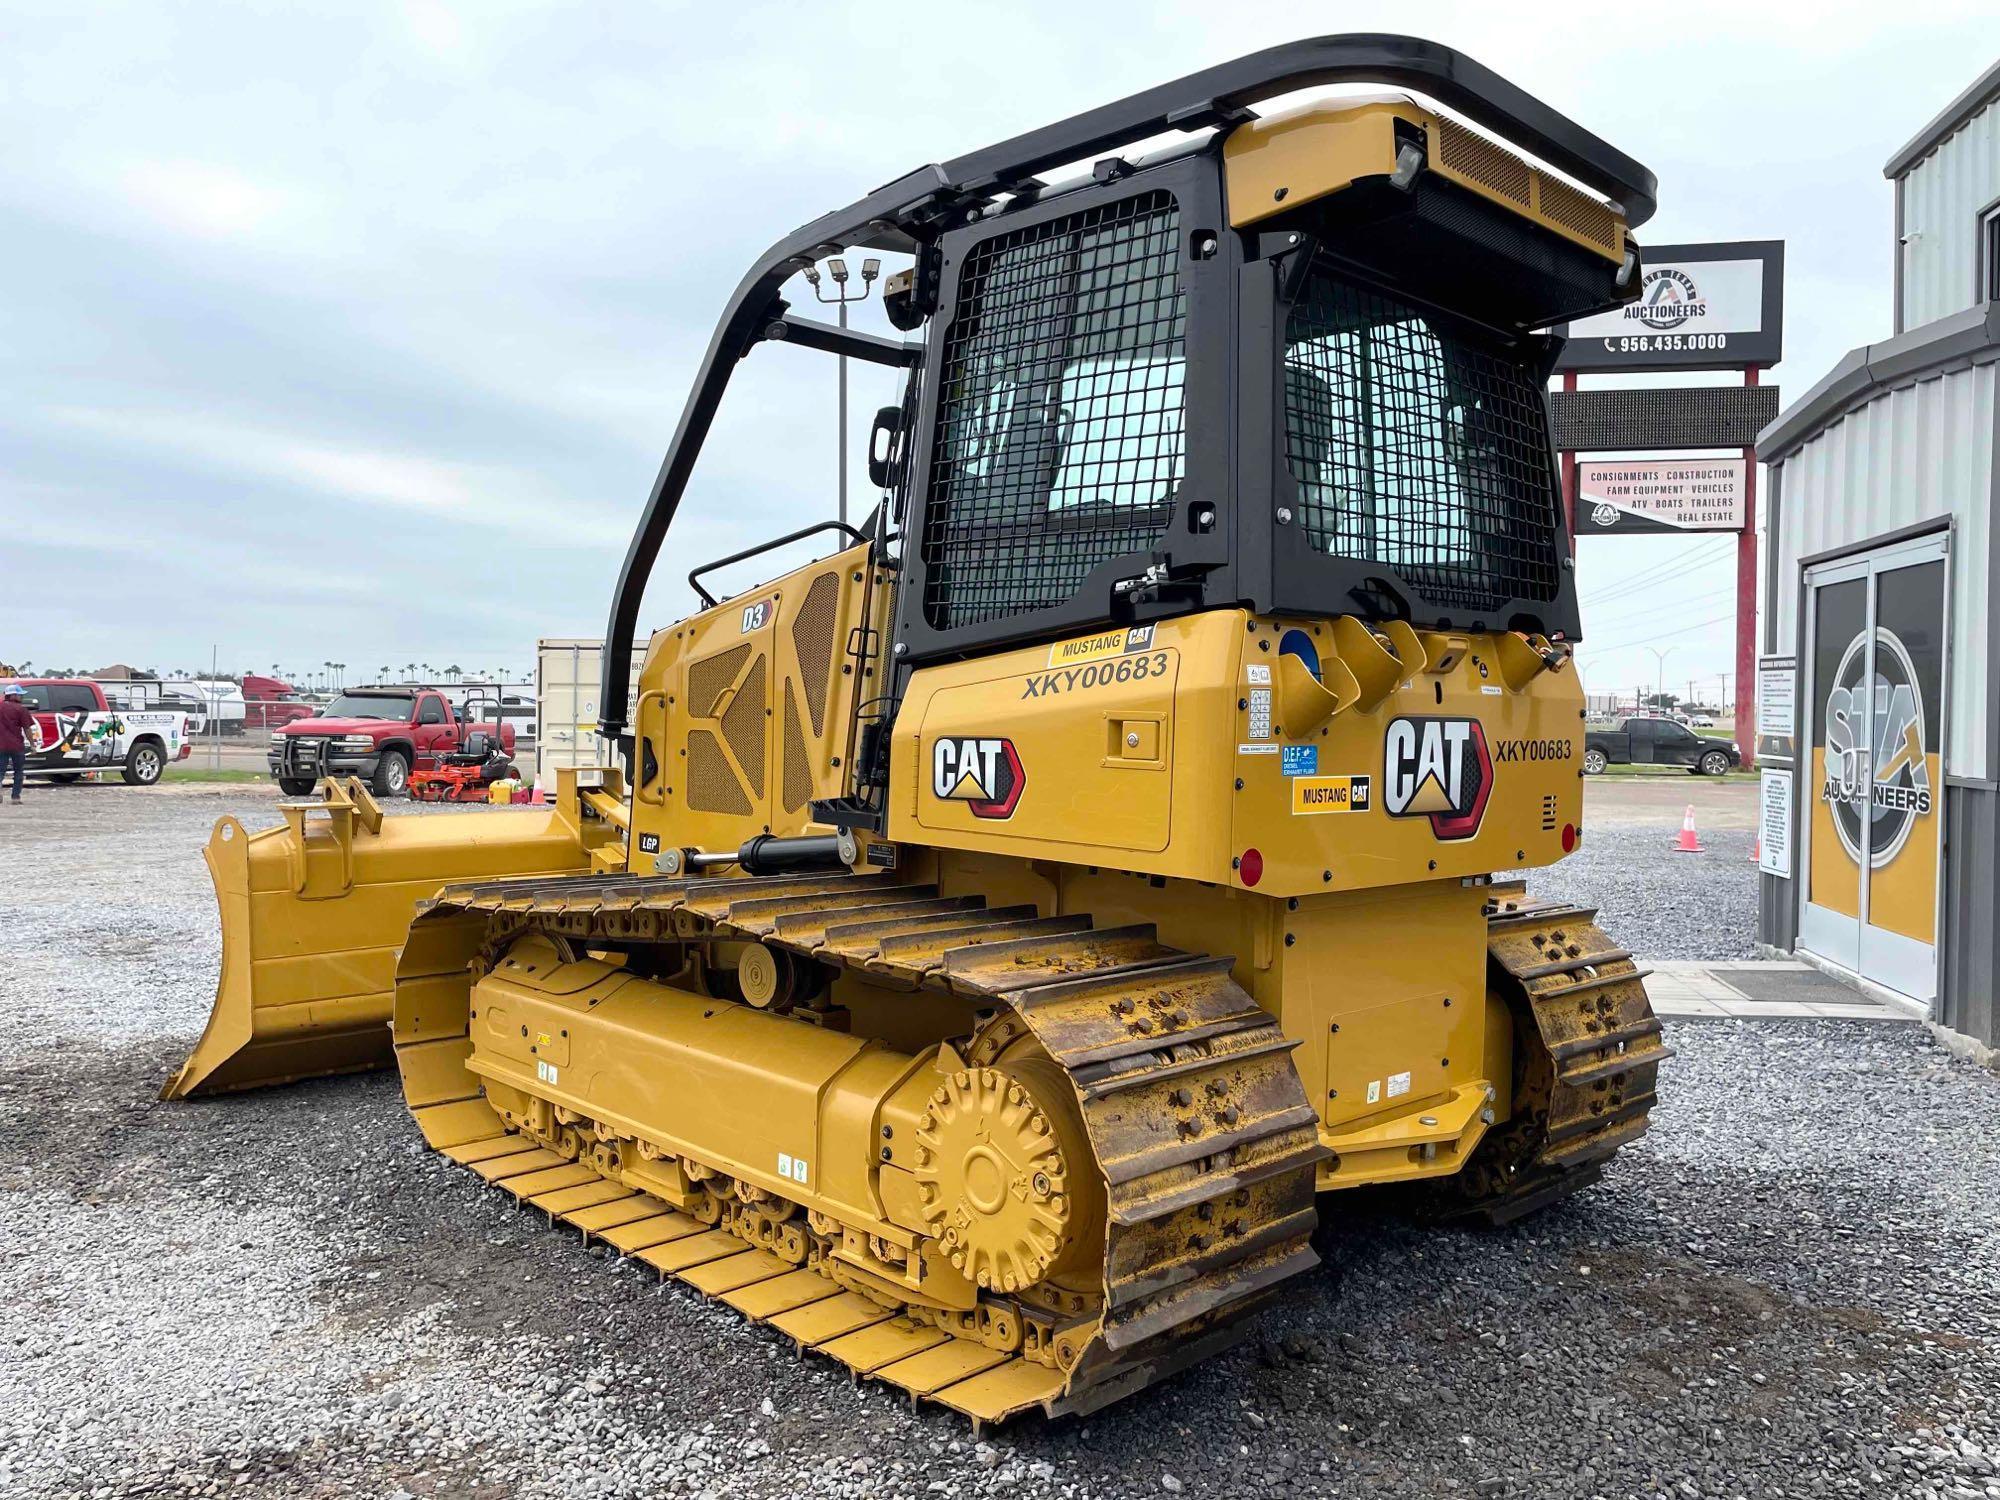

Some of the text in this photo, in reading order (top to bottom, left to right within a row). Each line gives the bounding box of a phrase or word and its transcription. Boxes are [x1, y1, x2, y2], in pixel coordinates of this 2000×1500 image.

[1624, 304, 1706, 319] AUCTIONEERS
[1620, 334, 1727, 352] 956.435.0000
[1590, 469, 1734, 481] CONSIGNMENTS CONSTRUCTION
[1607, 484, 1734, 495] FARM EQUIPMENT VEHICLES
[1631, 498, 1733, 509] ATV BOATS TRAILERS
[1677, 512, 1733, 522] REAL ESTATE
[742, 603, 764, 633] D3
[1063, 627, 1150, 657] MUSTANG CAT
[1022, 653, 1168, 699] XKY00683
[1283, 747, 1302, 763] D.E.F.
[1496, 740, 1571, 762] XKY00683
[935, 738, 1002, 800] CAT
[1385, 719, 1470, 814] CAT
[1303, 785, 1368, 804] MUSTANG CAT
[642, 836, 658, 850] LGP
